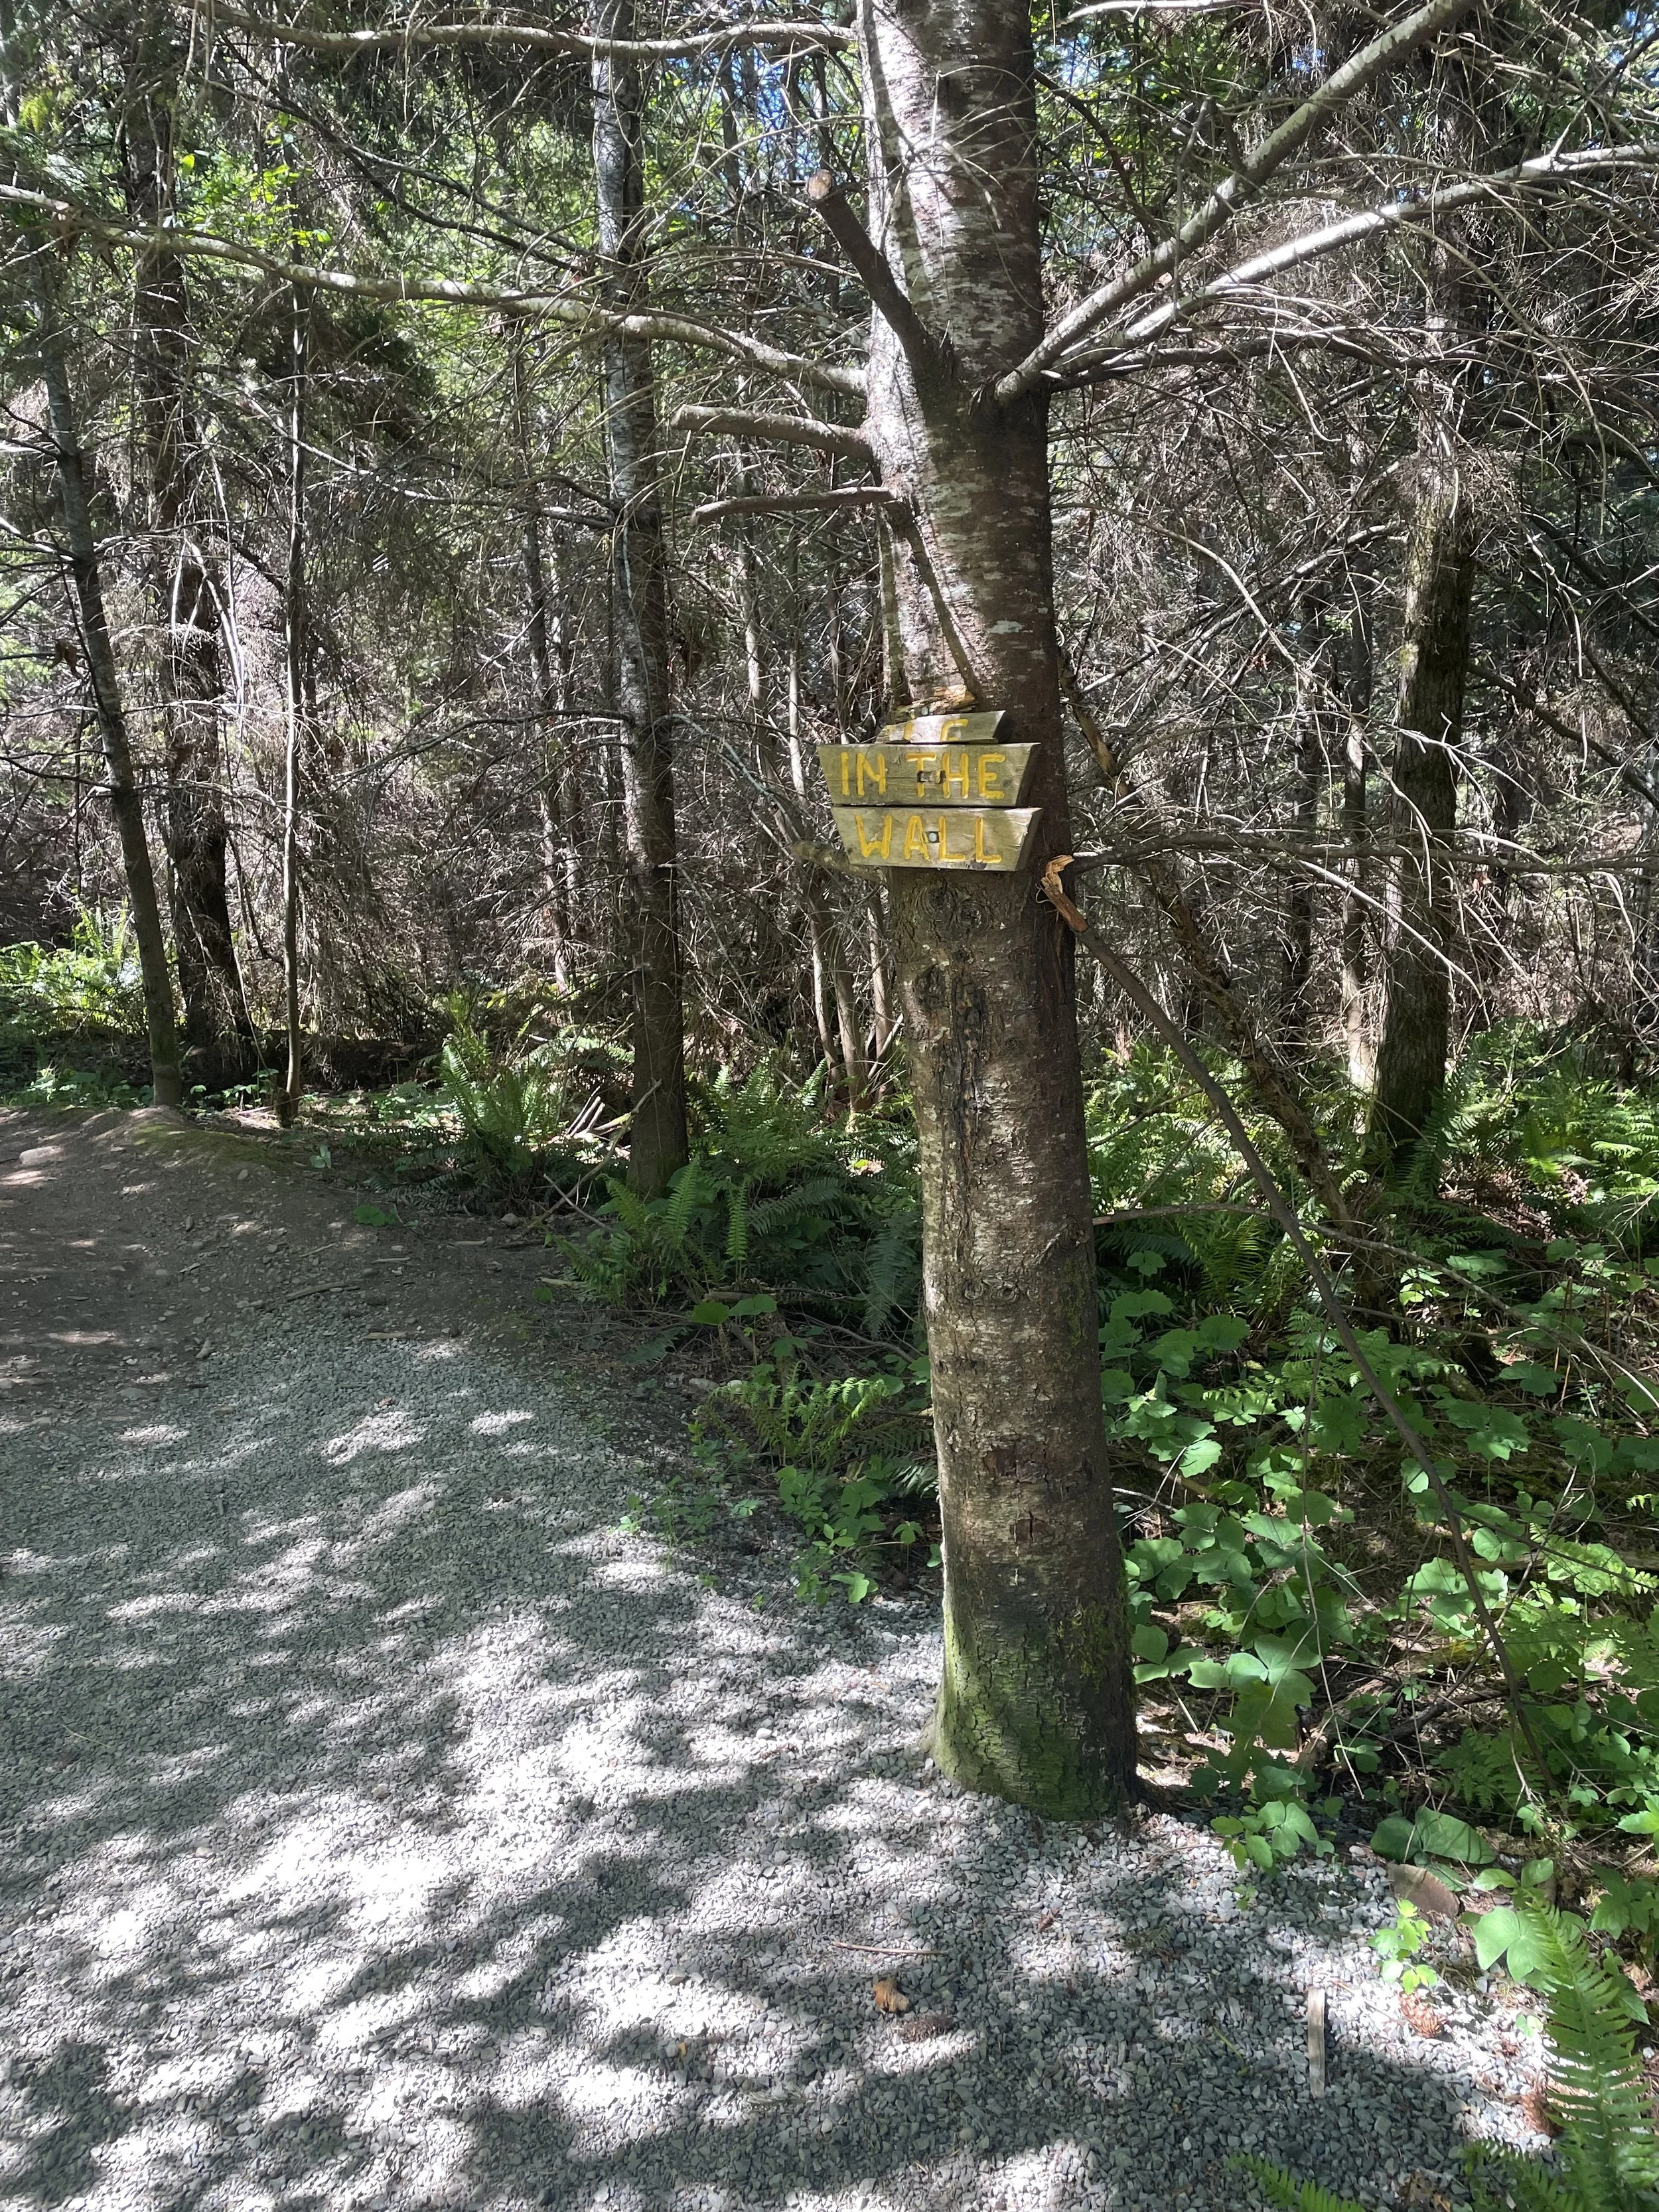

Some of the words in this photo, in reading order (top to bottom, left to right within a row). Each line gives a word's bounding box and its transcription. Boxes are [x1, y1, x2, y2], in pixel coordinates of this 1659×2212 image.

[841, 752, 886, 796] IN
[904, 752, 1005, 799] THE
[855, 815, 1001, 863] WALL
